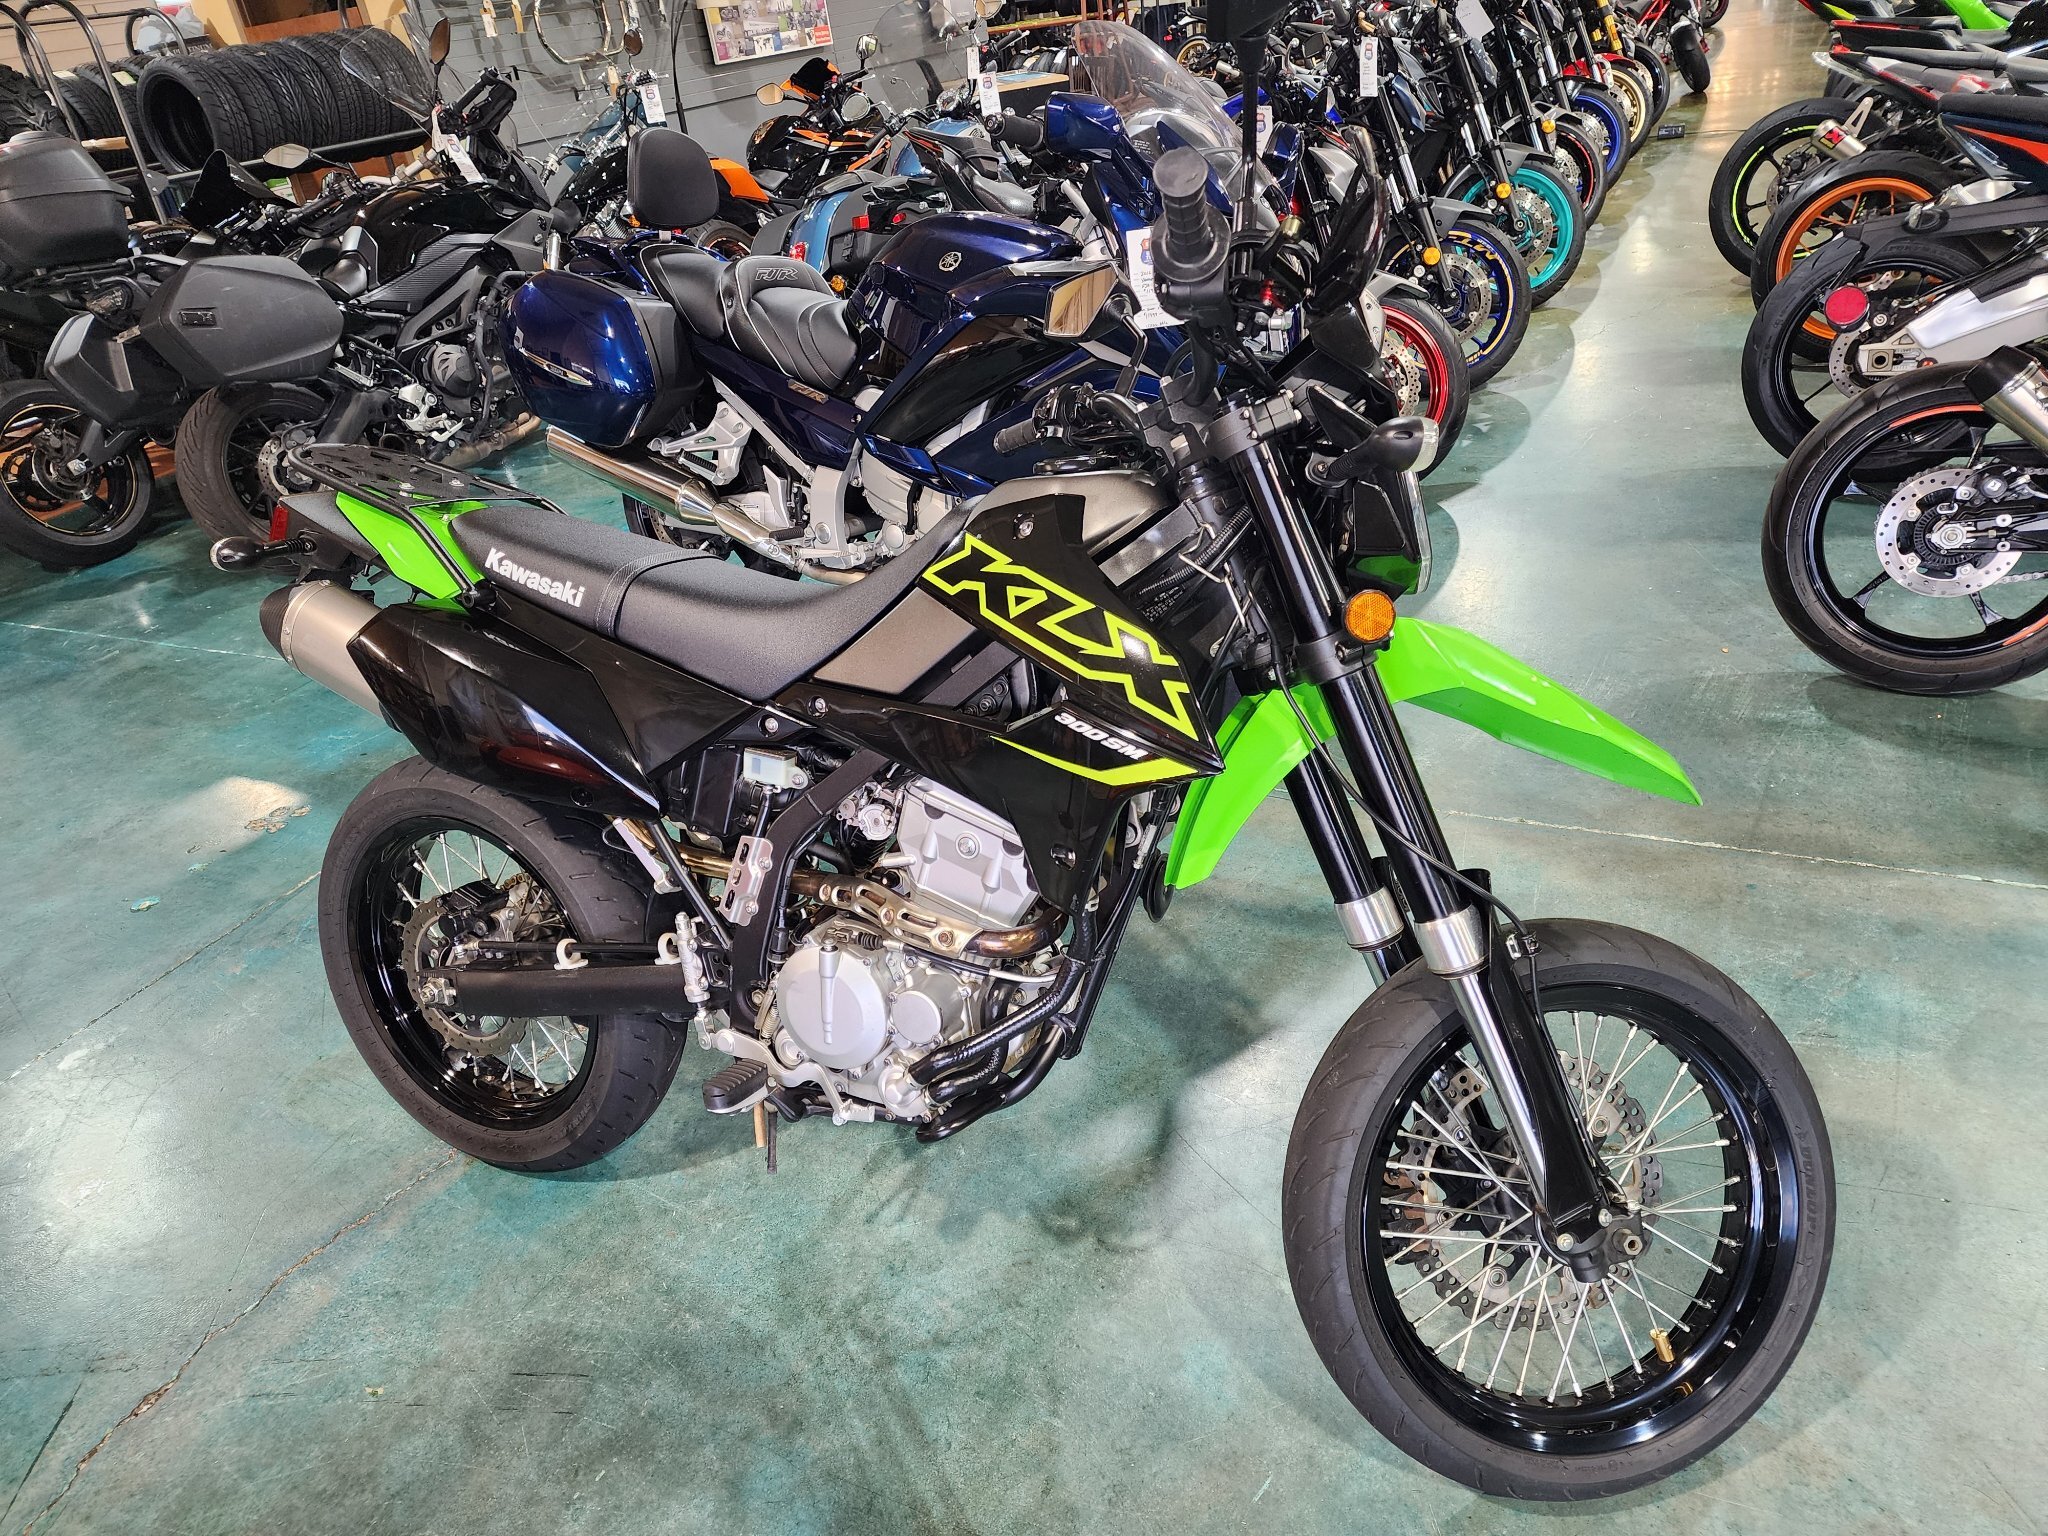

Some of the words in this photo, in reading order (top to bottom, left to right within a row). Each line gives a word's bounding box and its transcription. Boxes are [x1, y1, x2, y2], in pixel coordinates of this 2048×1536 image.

[755, 267, 799, 282] FJR
[484, 547, 586, 608] Kawasaki
[922, 532, 1199, 742] KLX
[1054, 712, 1149, 760] 300SM
